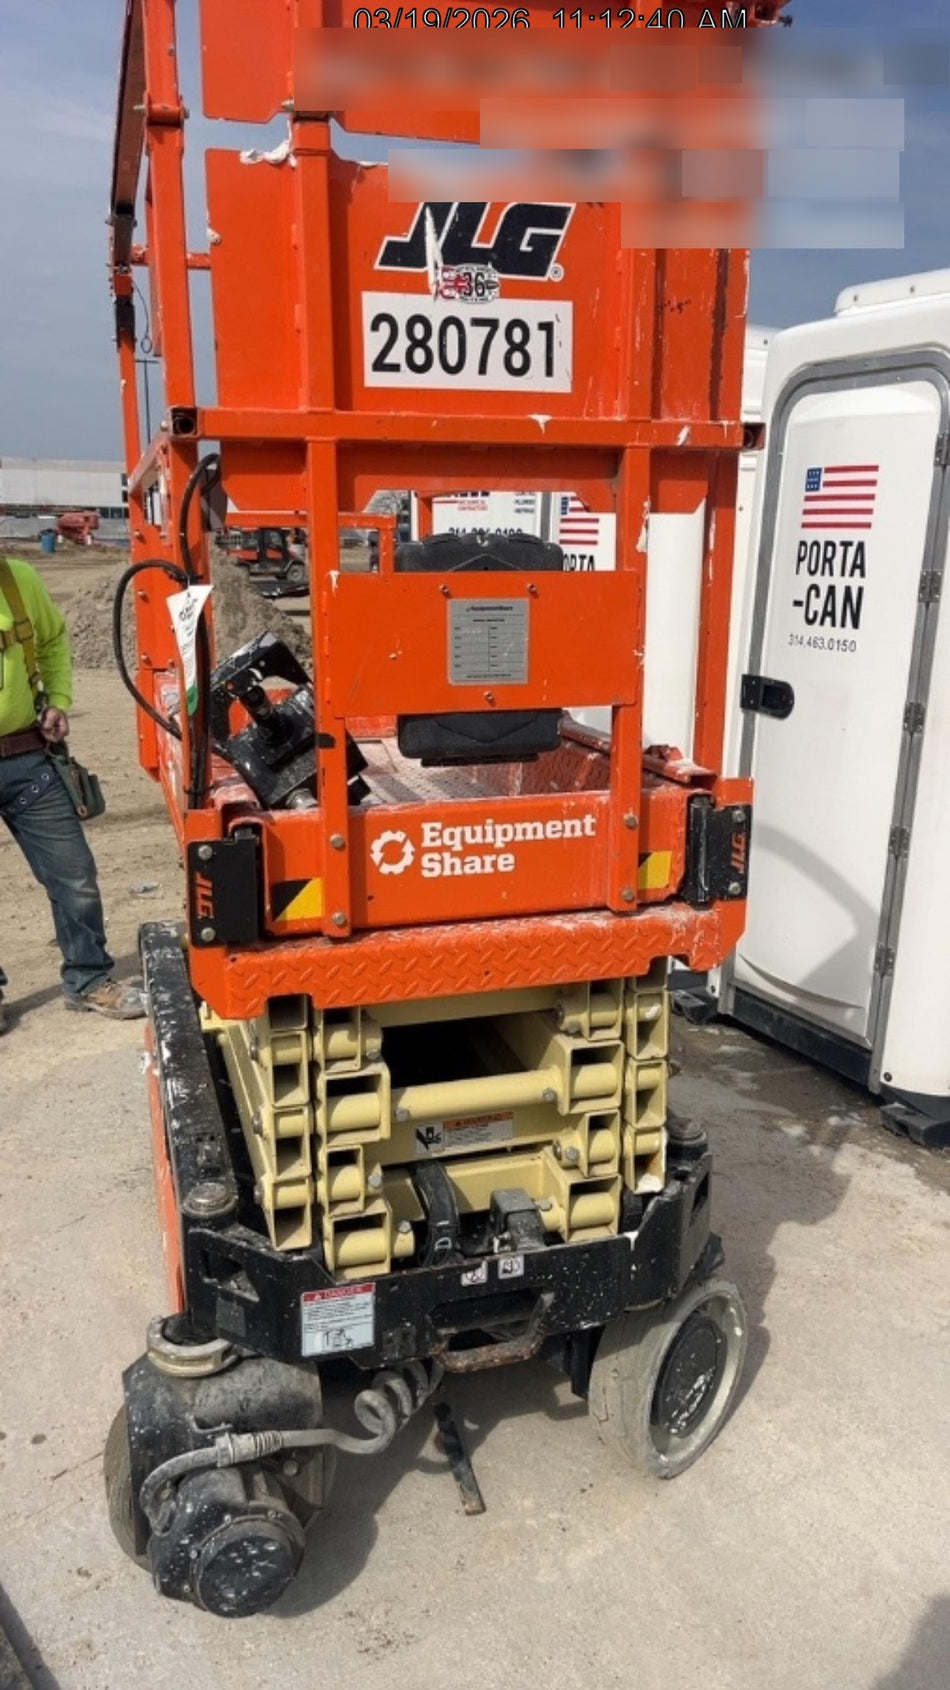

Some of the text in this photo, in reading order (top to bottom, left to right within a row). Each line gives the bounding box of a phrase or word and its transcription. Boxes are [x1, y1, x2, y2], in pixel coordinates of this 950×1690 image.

[374, 202, 577, 281] JLG
[370, 312, 555, 378] 280781
[562, 553, 596, 572] ORTA
[795, 540, 866, 578] PORTA
[792, 583, 864, 630] -CAN
[788, 633, 857, 652] 314.463.0150
[421, 814, 596, 851] Equipment
[421, 851, 515, 878] Share
